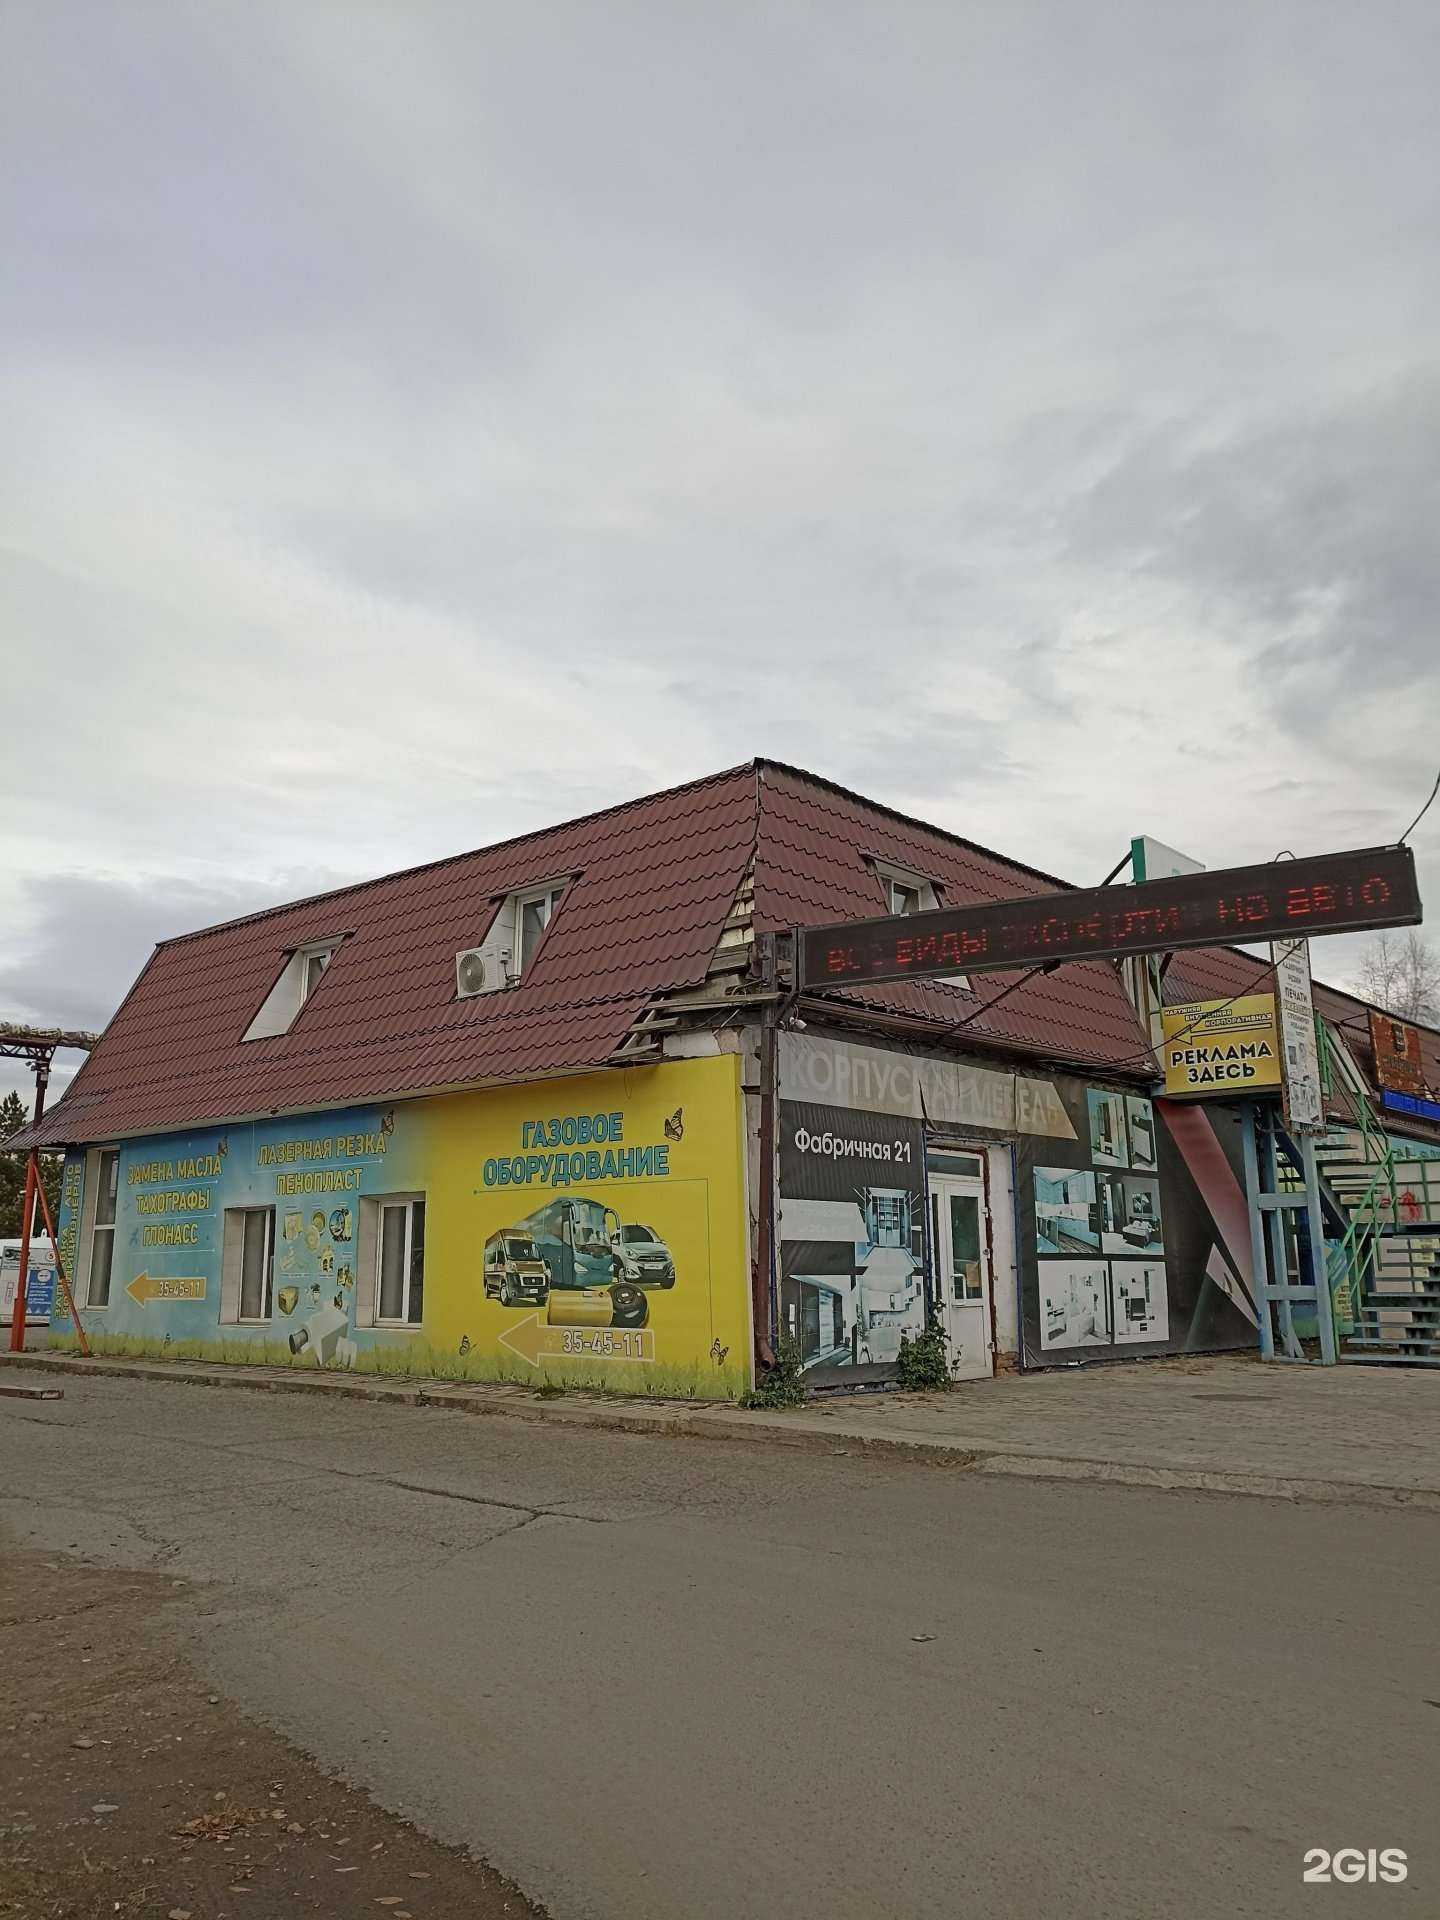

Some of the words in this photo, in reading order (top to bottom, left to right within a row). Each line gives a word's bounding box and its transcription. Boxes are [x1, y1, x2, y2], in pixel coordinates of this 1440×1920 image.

[1205, 1013, 1272, 1027] КОРПОРАТИВНАЯ
[1171, 1041, 1272, 1067] РЕКЛАМА
[1188, 1062, 1256, 1083] ЗДЕСЬ
[522, 1112, 624, 1149] ГАЗОВОЕ
[258, 1138, 332, 1165] ЛАЗЕРНАЯ
[335, 1133, 386, 1157] РЕЗКА
[794, 1127, 891, 1160] Фабричная
[894, 1140, 911, 1163] 21
[127, 1161, 174, 1185] ЗАМЕНА
[177, 1155, 222, 1179] МАСЛА
[483, 1145, 670, 1186] ОБОРУДОВАНИЕ
[276, 1168, 363, 1195] ПЕНОПЛАСТ
[136, 1187, 211, 1215] ТАХОГРАФЫ
[143, 1223, 199, 1246] ГЛОНАСС
[159, 1280, 200, 1297] 35-45-11
[562, 1330, 643, 1357] 35-45-11
